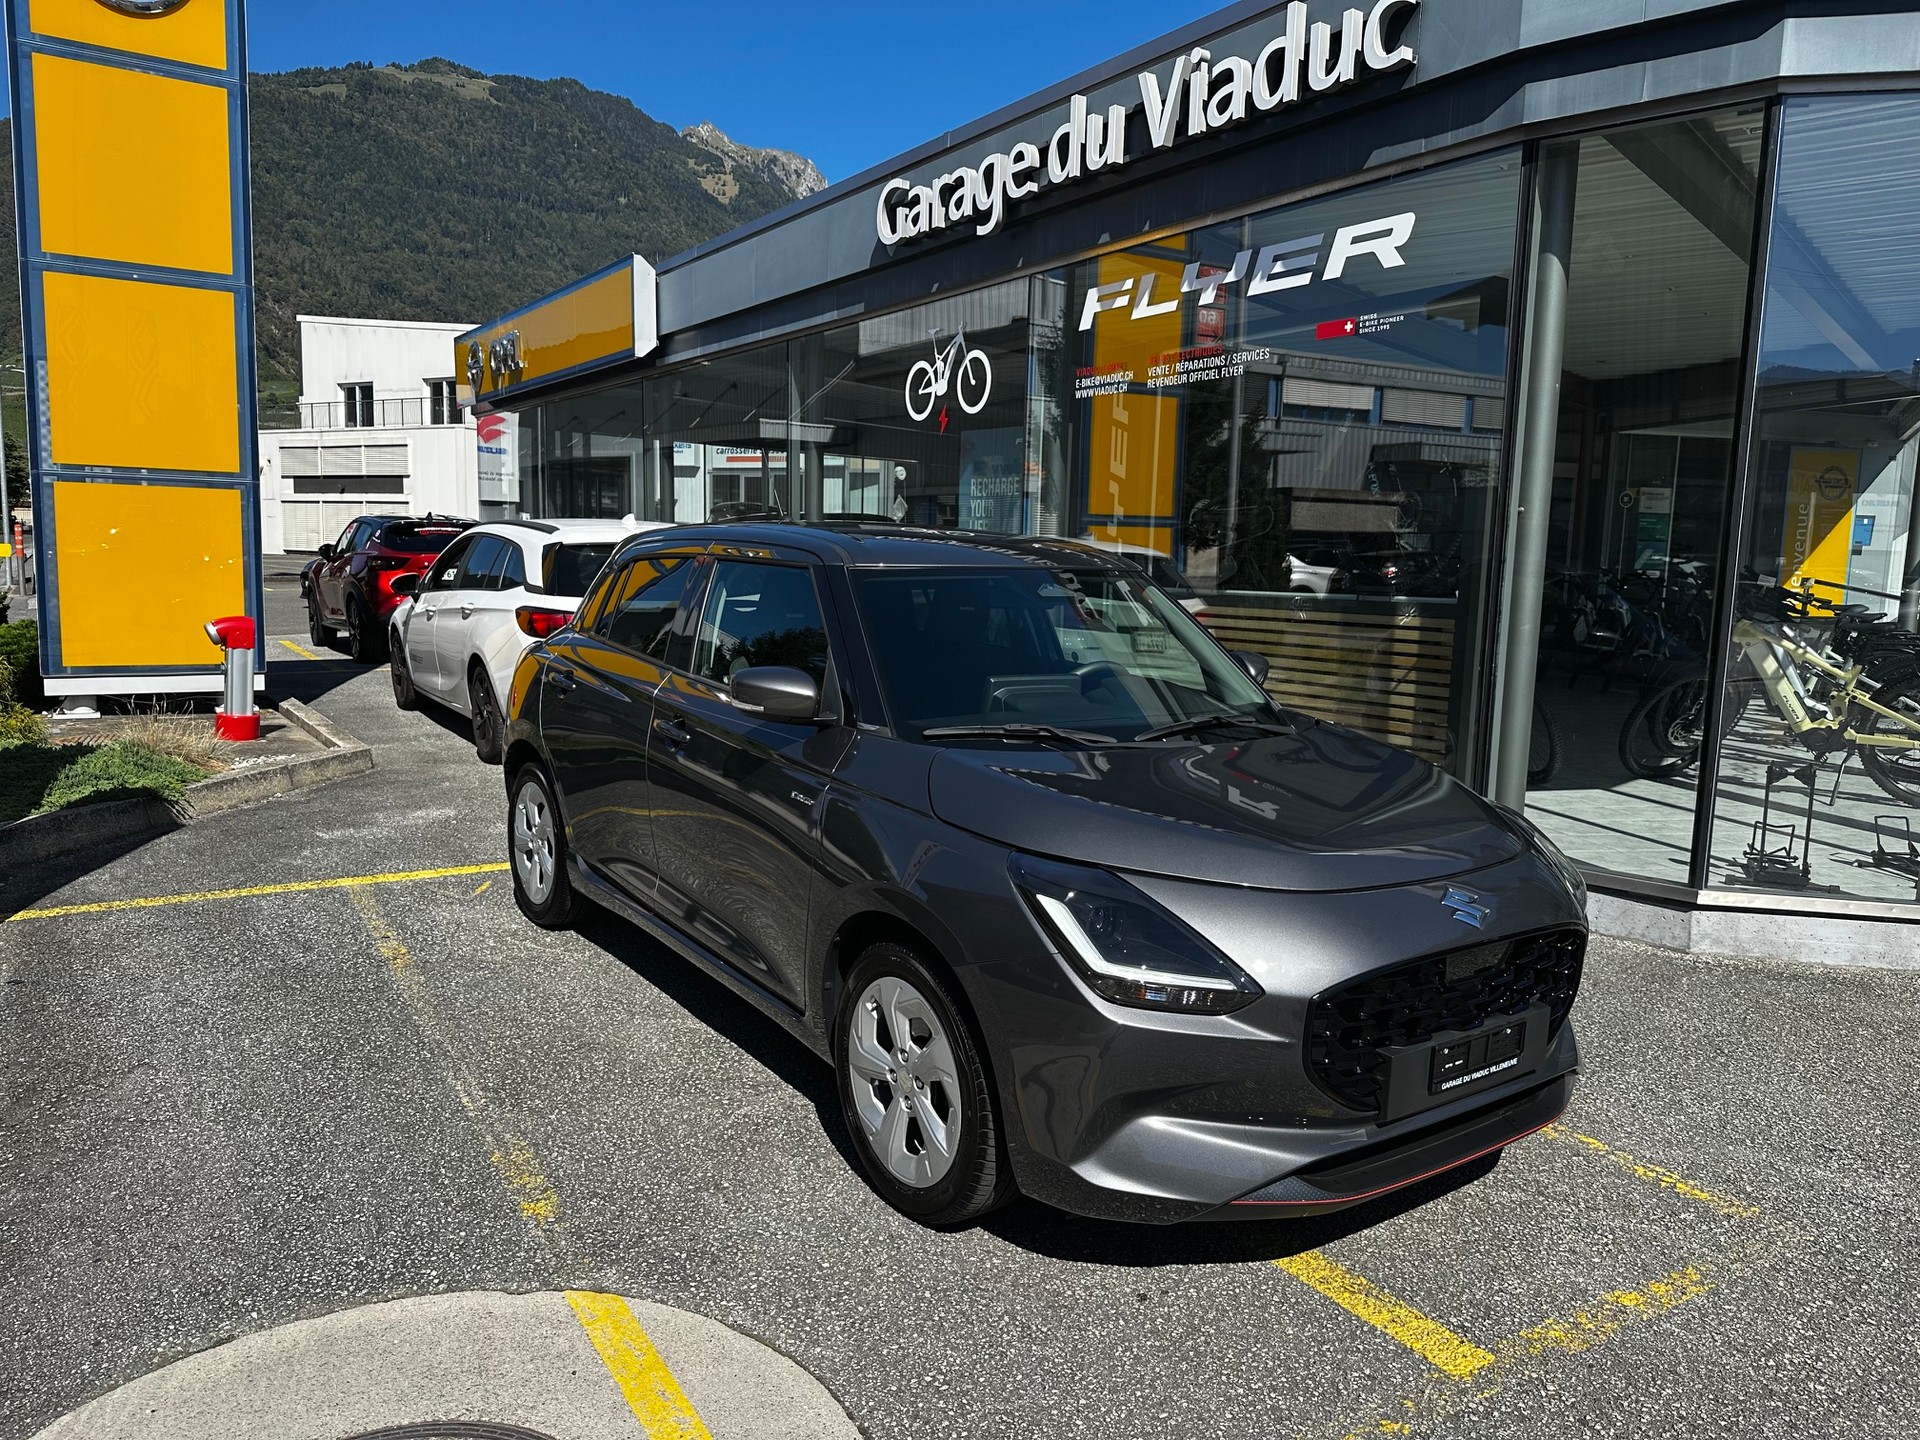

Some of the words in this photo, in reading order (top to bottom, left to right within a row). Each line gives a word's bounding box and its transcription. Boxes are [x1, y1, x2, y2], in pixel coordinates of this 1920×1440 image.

[876, 141, 1040, 246] Garage
[1047, 94, 1126, 185] du
[1138, 0, 1418, 149] Viaduc
[1078, 211, 1416, 332] FLYER
[1360, 326, 1375, 334] SINCE
[1147, 364, 1170, 377] VENTE
[1175, 355, 1225, 373] RÉPARATIONS
[1232, 348, 1270, 364] SERVICES
[1075, 371, 1134, 388] E-BIKE@VIADUC.CH
[1147, 374, 1188, 389] REVENDEUR
[1189, 369, 1219, 383] OFFICIEL
[1221, 365, 1243, 378] FLYER
[970, 477, 1020, 497] RECHARGE
[970, 499, 994, 517] YOUR
[1441, 1077, 1463, 1090] GARAGE
[1463, 1074, 1471, 1084] DU
[1471, 1067, 1490, 1080] VIADUC
[1490, 1057, 1518, 1073] VILLENEUVE
